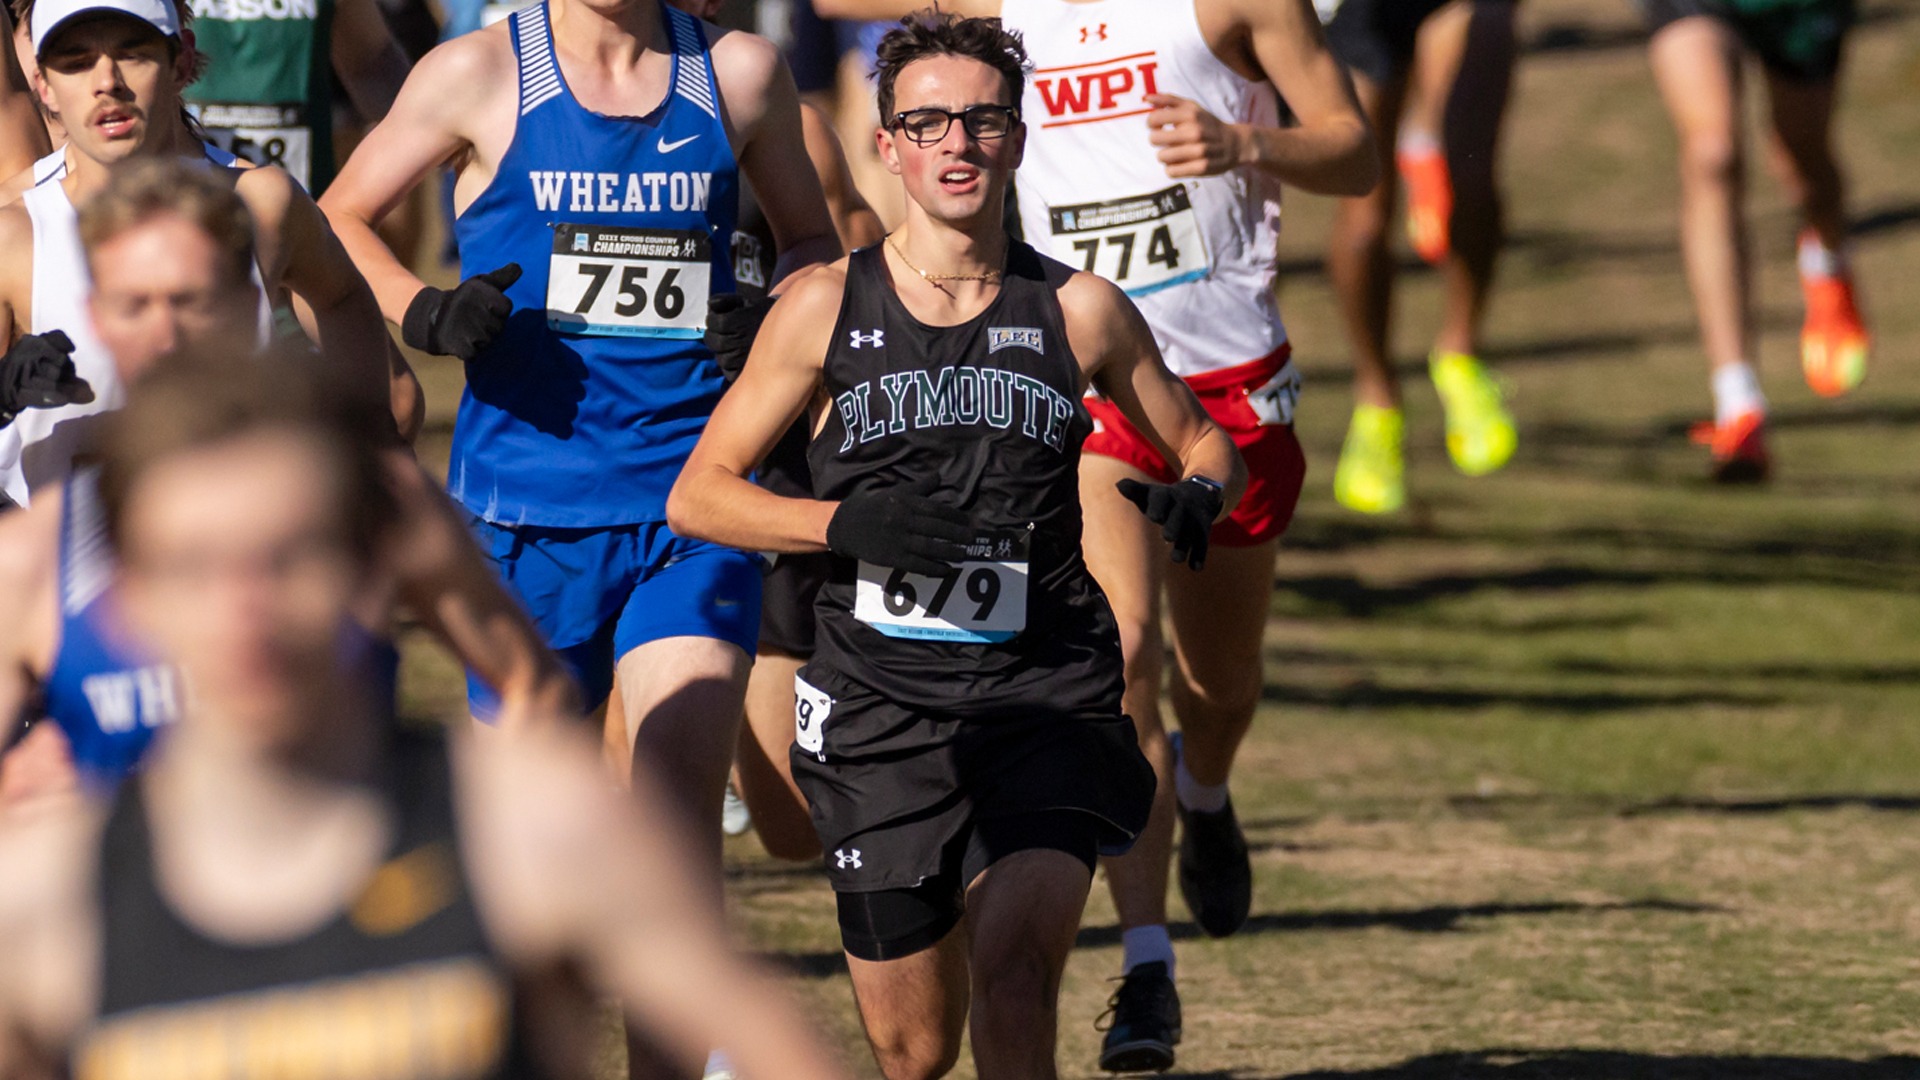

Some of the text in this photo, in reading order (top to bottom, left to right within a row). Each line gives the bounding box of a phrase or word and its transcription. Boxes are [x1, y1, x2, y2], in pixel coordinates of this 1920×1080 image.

[1035, 62, 1158, 117] WPI
[529, 171, 712, 212] WHEATON
[593, 241, 680, 257] CHAMPIONSHIPS
[620, 235, 645, 243] CROSS
[645, 236, 678, 244] COUNTRY
[1073, 224, 1180, 281] 774
[575, 263, 685, 319] 756
[991, 330, 1040, 349] LEC
[837, 366, 1074, 454] PLYMOUTH
[883, 567, 1002, 621] 679
